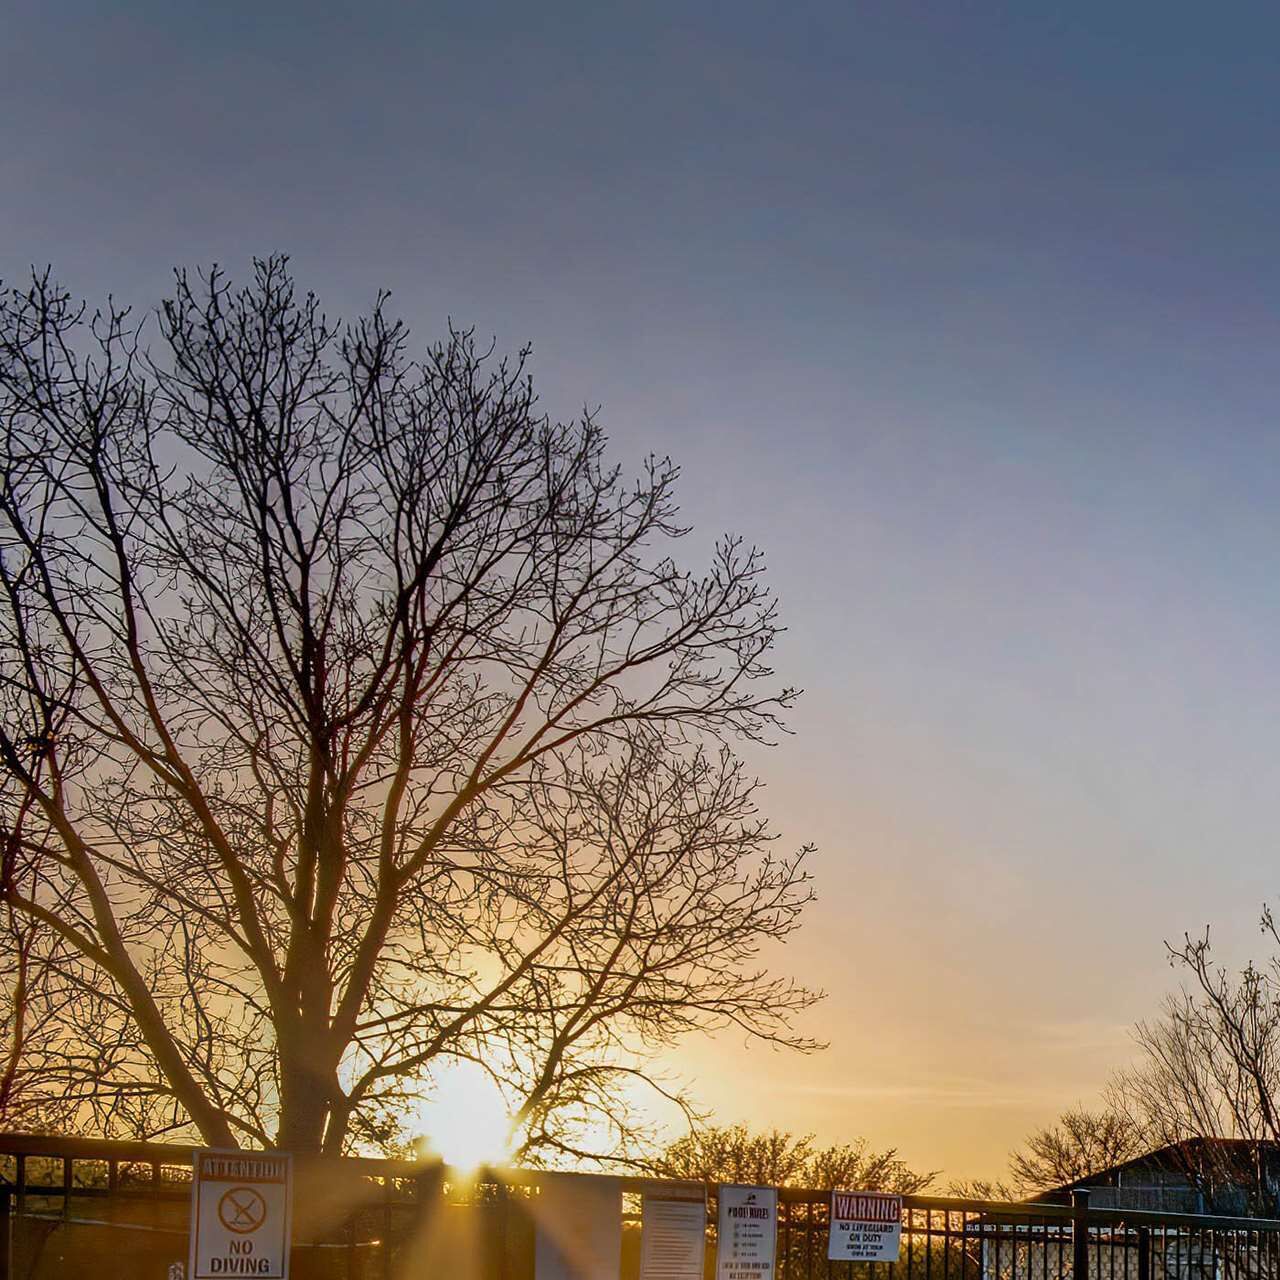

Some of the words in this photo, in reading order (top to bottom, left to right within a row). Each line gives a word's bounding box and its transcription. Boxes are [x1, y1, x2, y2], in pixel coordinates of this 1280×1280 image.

[837, 1196, 898, 1220] WARNING
[840, 1223, 850, 1231] NO
[852, 1223, 894, 1233] LIFEGUARD
[849, 1233, 860, 1241] ON
[862, 1233, 881, 1242] DUTY
[229, 1239, 253, 1255] NO
[210, 1257, 270, 1273] DIVING
